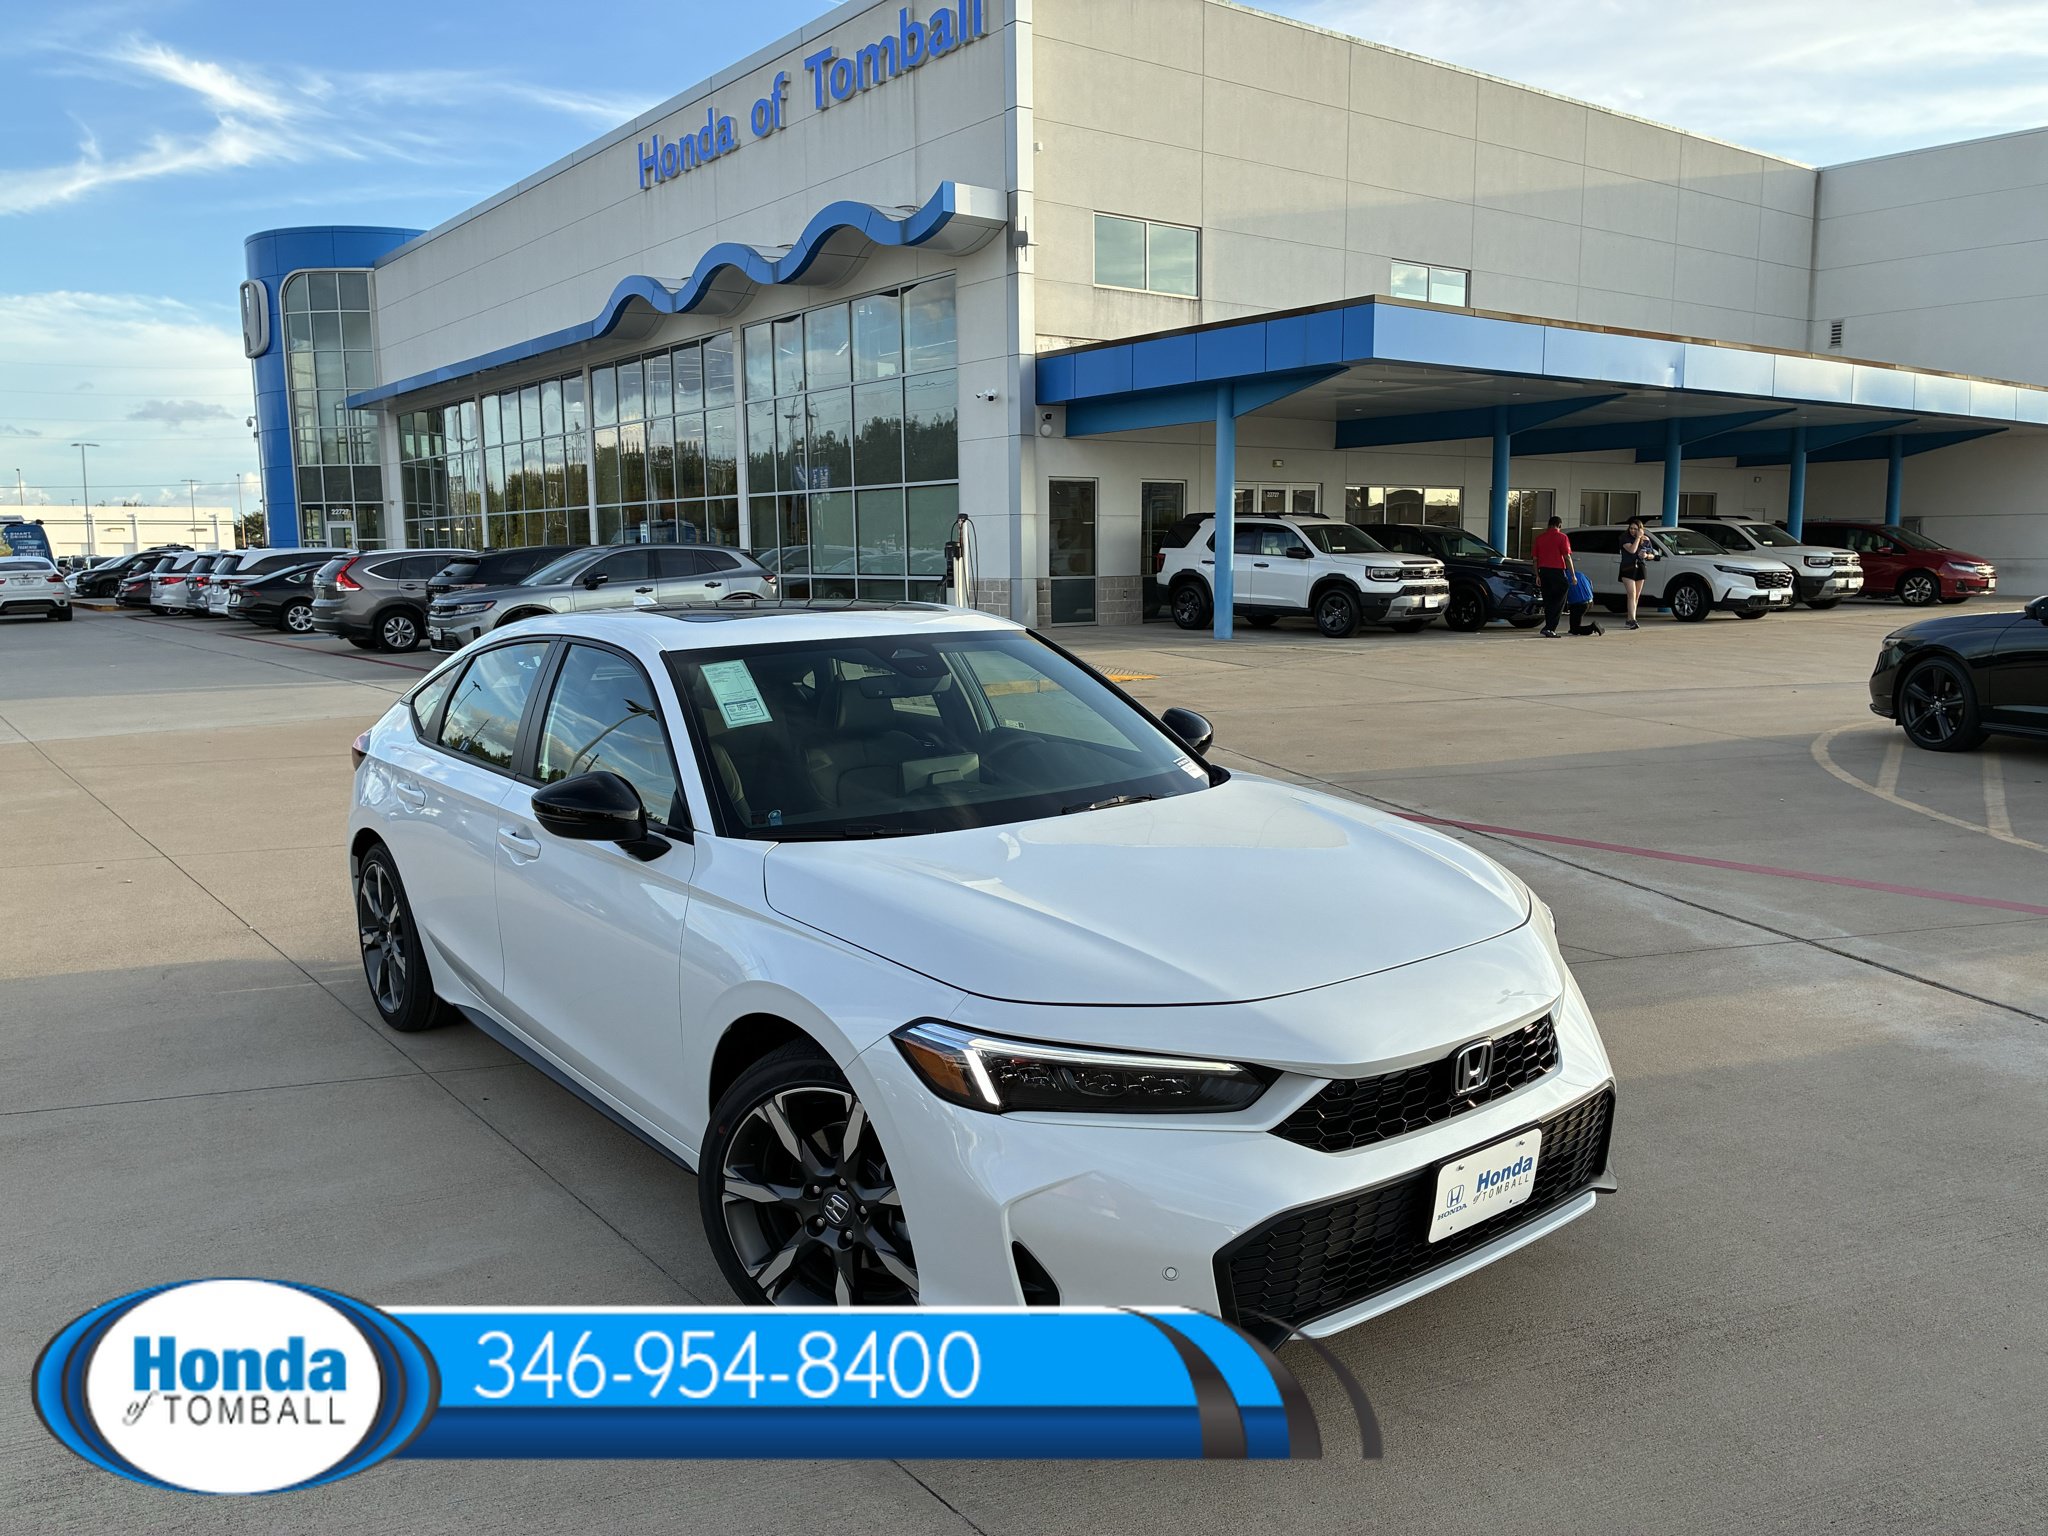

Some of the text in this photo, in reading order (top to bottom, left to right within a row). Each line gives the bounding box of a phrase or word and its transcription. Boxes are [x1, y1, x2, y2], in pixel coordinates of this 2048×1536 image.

[638, 0, 988, 190] Honda of Tomball
[1476, 1155, 1534, 1192] Honda
[1482, 1174, 1530, 1202] TOMBALL
[1437, 1203, 1468, 1220] HONDA
